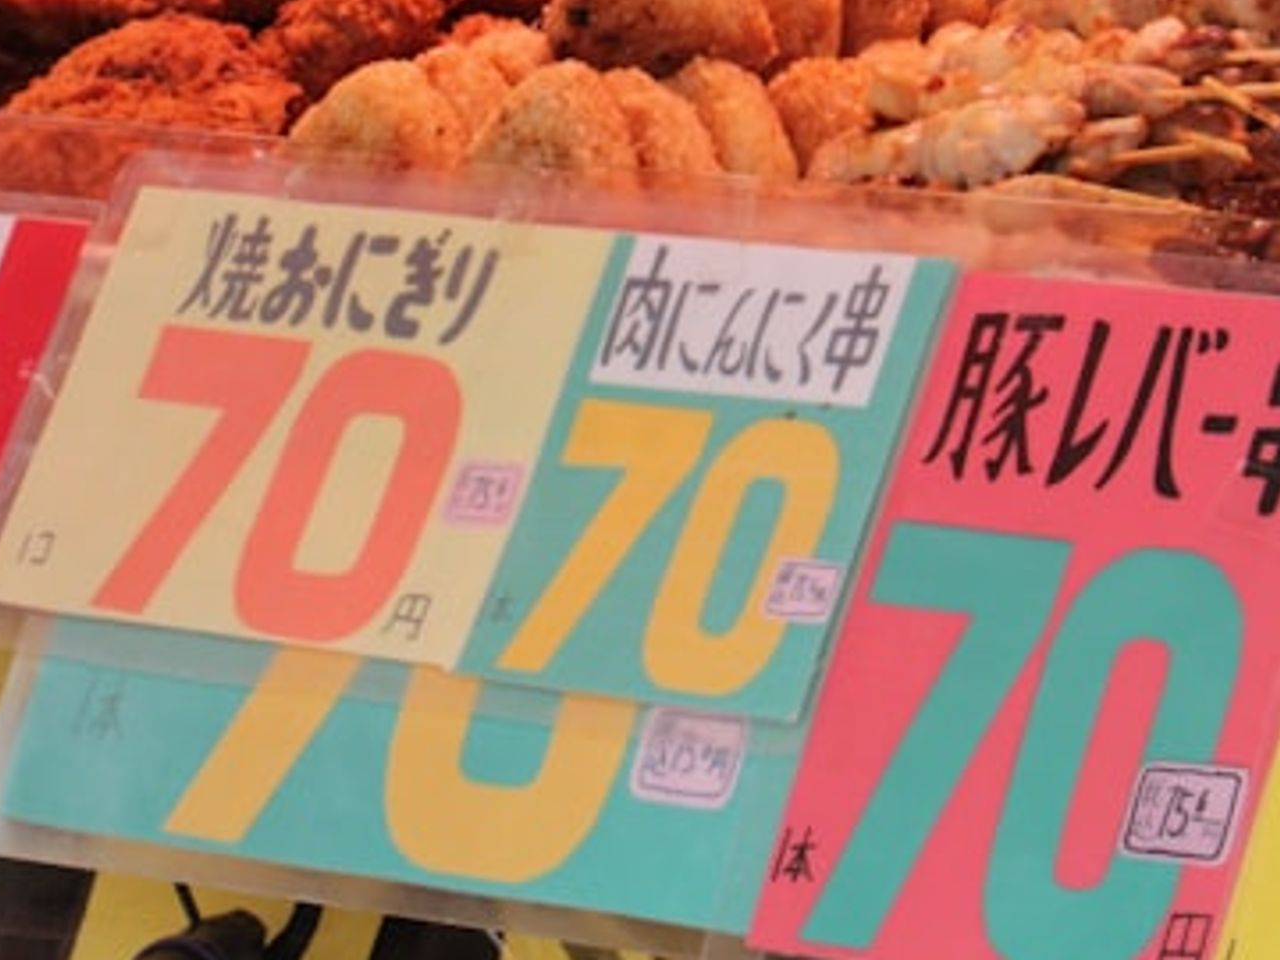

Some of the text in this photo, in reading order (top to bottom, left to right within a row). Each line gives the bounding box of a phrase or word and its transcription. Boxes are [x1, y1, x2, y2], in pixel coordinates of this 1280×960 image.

[176, 212, 501, 347] 焼おにぎり
[599, 243, 893, 395] 肉にんにく串
[88, 323, 463, 643] 70
[495, 397, 841, 696] 70
[380, 592, 432, 642] 円
[797, 519, 1246, 960] 70
[771, 826, 817, 885] 1本
